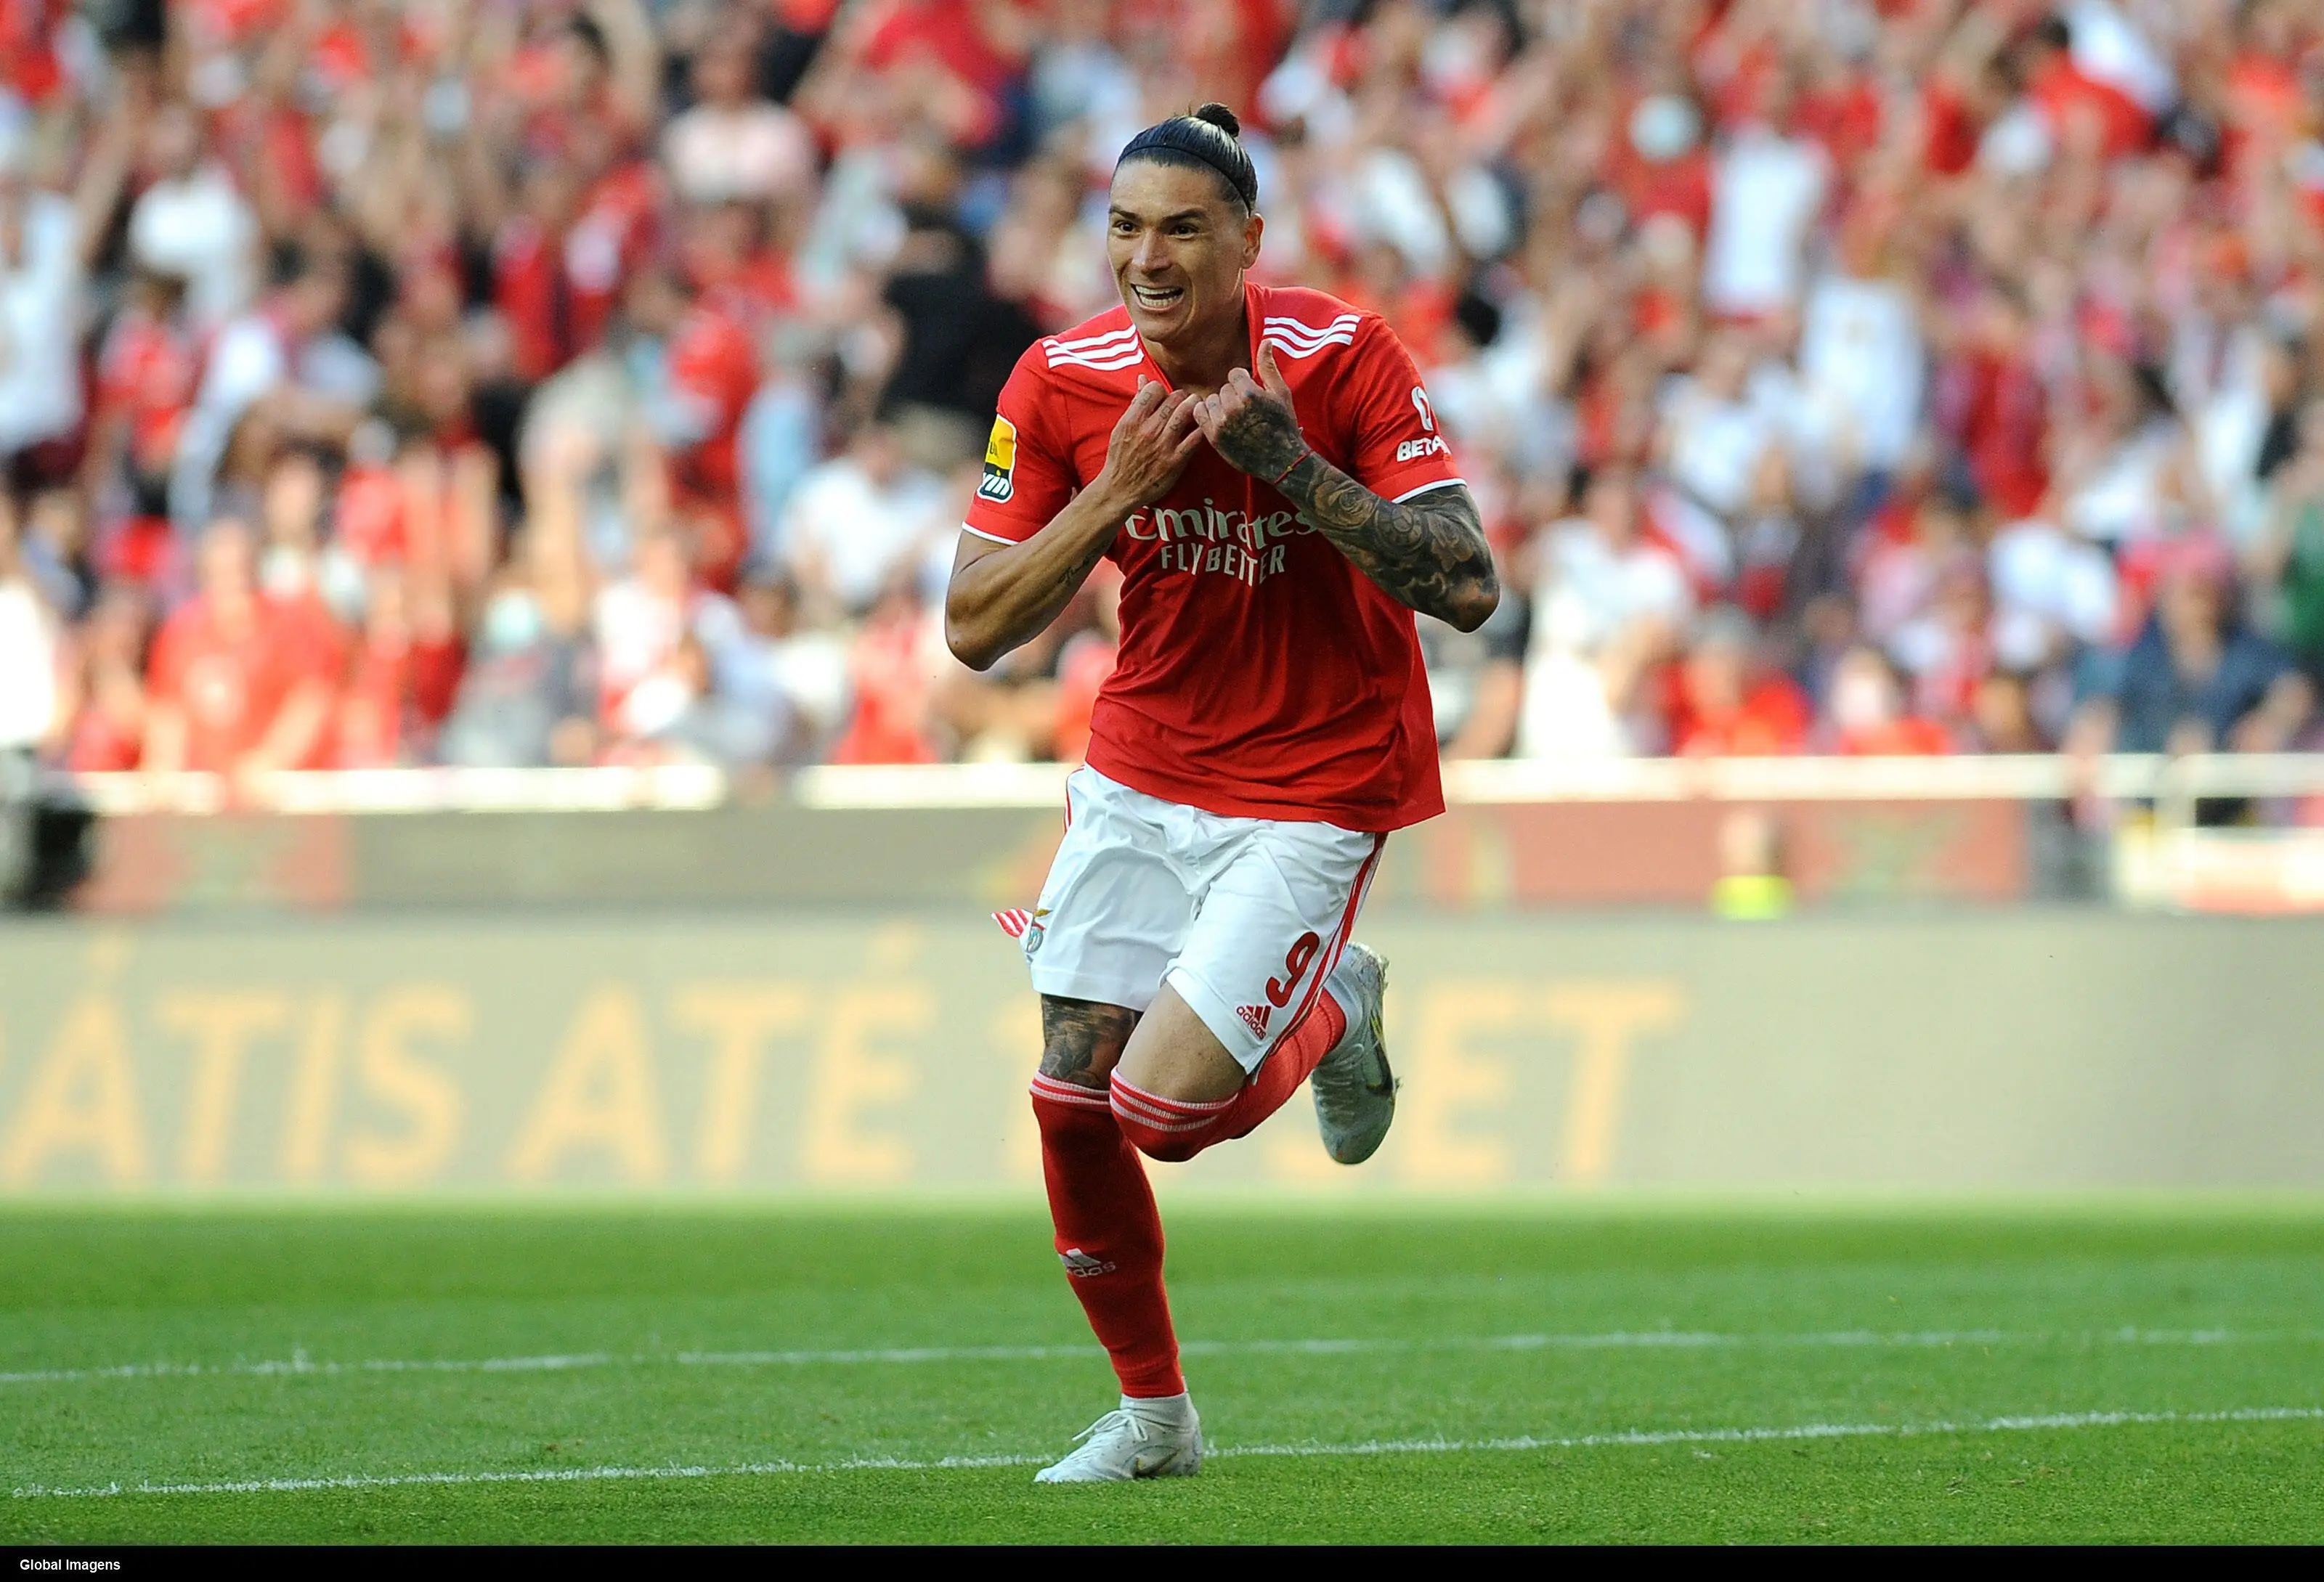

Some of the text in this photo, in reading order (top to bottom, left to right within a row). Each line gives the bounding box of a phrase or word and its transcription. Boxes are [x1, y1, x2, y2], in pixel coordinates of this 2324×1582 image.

[1397, 435, 1452, 462] BETA
[1125, 497, 1317, 551] Emirates
[1265, 931, 1320, 1008] 9
[1235, 1006, 1267, 1040] adidas
[0, 934, 471, 1186] ÁTIS
[511, 921, 937, 1186] ATÉ
